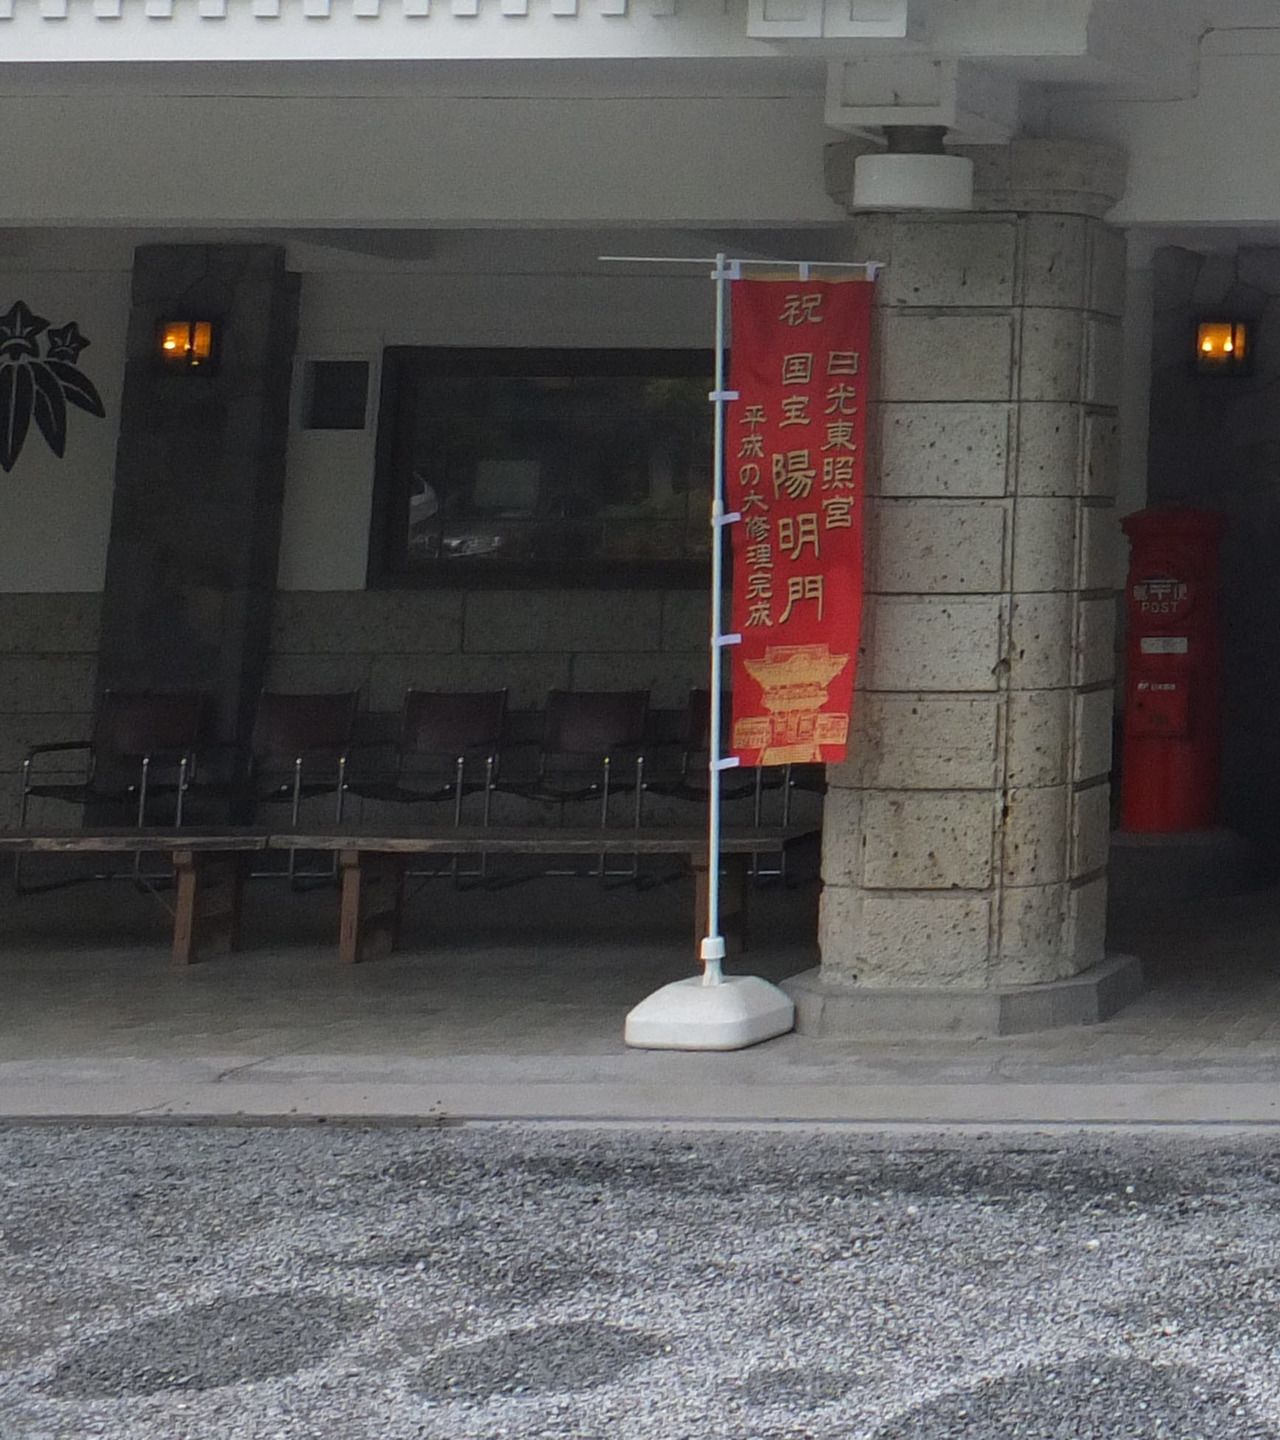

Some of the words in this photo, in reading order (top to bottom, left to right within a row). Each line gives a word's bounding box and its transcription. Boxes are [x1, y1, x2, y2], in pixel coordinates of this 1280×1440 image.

[780, 293, 824, 326] 祝
[737, 405, 774, 627] 平成の大修理完成
[772, 352, 825, 622] 国宝陽明門
[821, 351, 859, 529] 日光東照宮
[1141, 601, 1180, 613] POST
